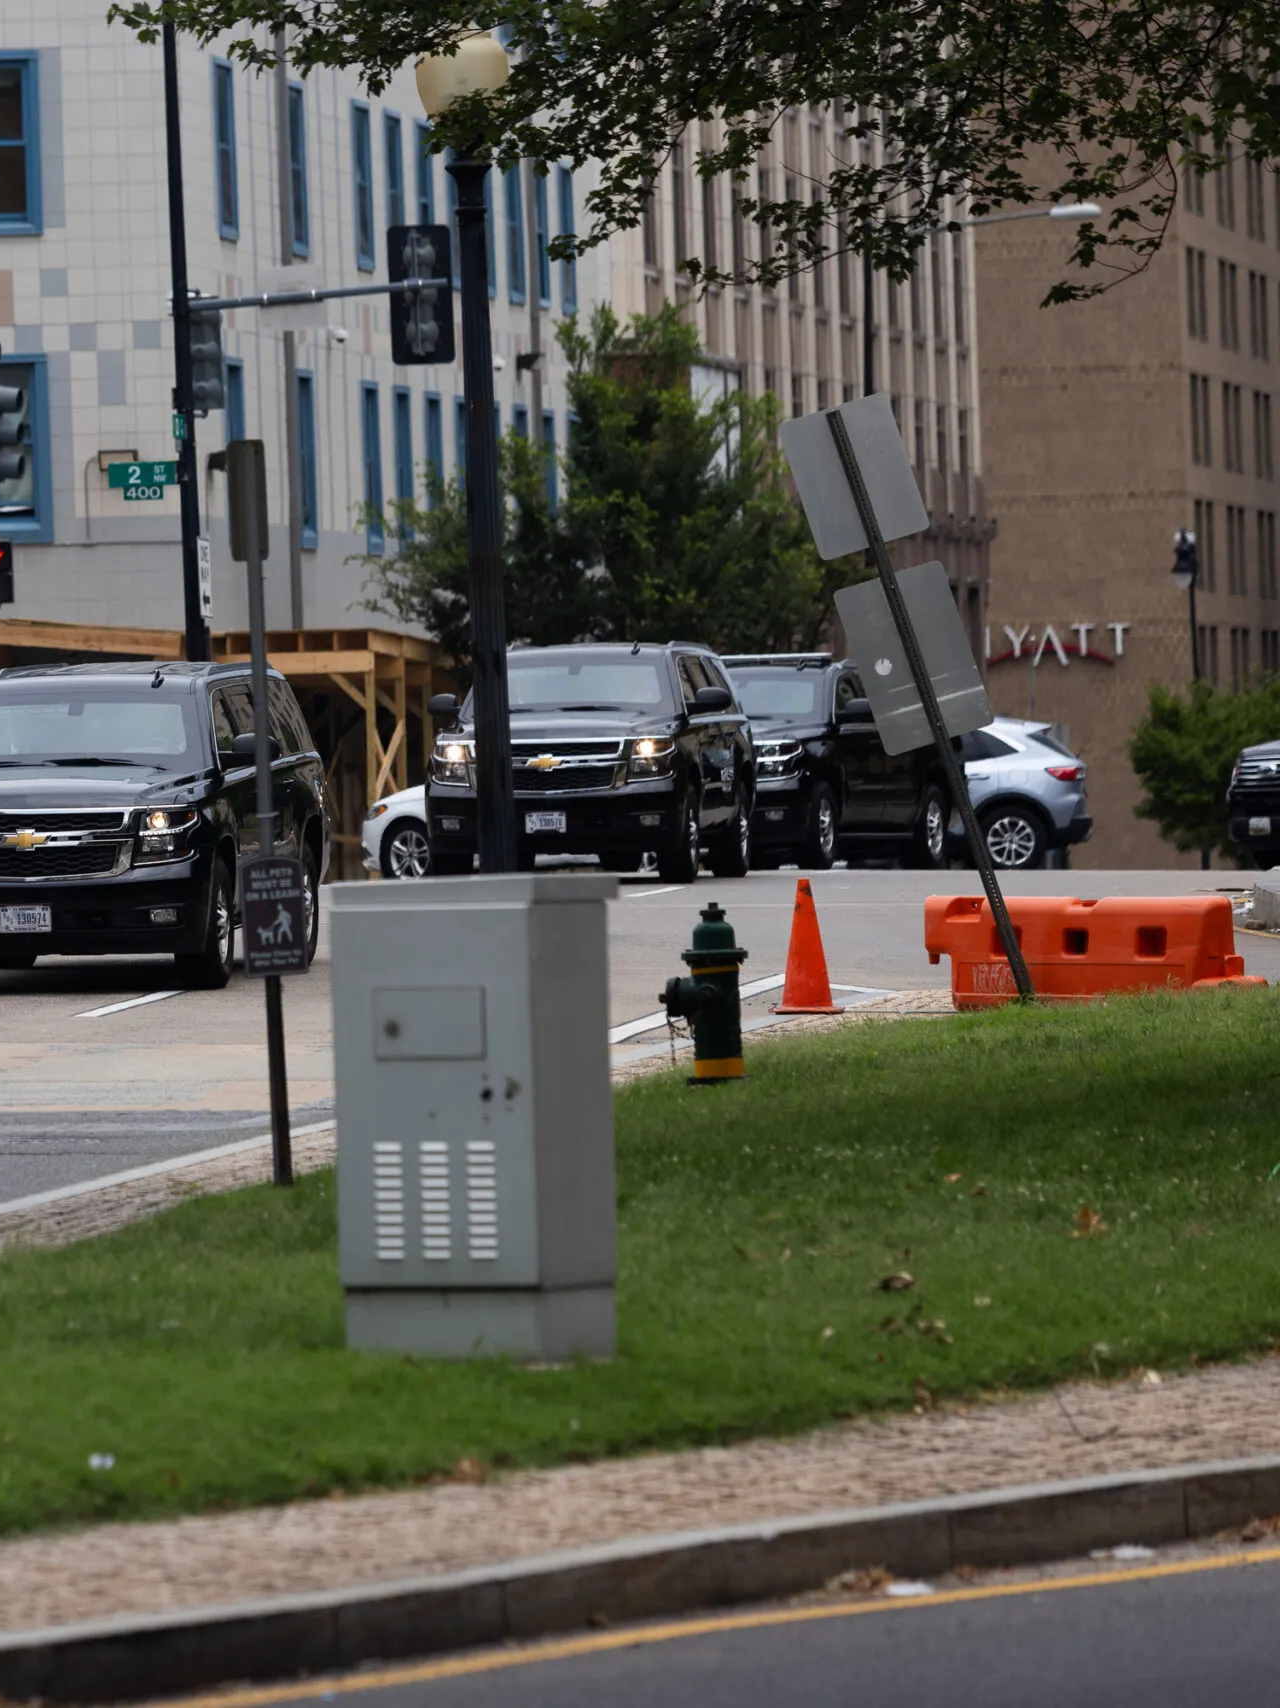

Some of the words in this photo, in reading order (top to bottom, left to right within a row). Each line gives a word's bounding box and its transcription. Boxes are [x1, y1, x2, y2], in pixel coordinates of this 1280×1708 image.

[127, 465, 141, 484] 2
[153, 464, 166, 473] ST
[153, 474, 167, 482] NW
[126, 486, 161, 499] 400
[251, 870, 267, 879] ALL
[269, 867, 293, 878] PETS
[252, 880, 278, 890] MUST
[279, 878, 293, 888] BE
[246, 892, 260, 902] ON
[261, 891, 268, 900] A
[270, 890, 300, 900] LEASH
